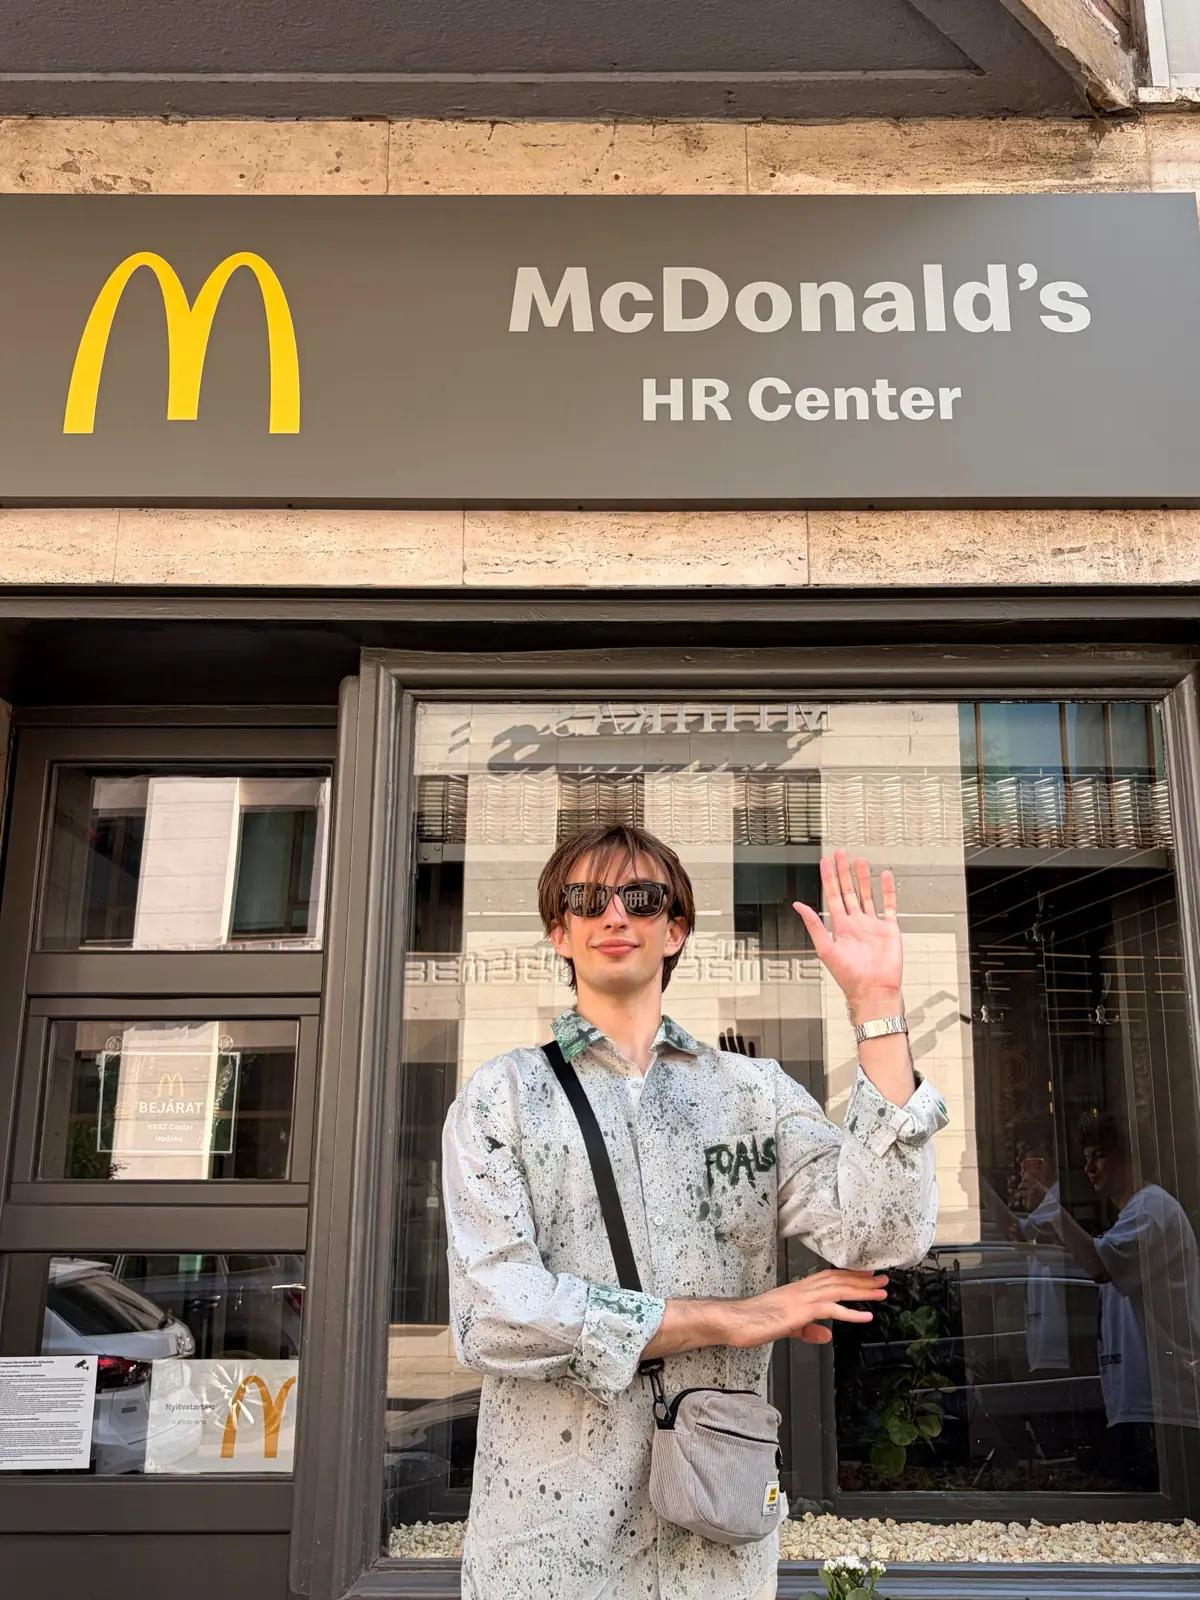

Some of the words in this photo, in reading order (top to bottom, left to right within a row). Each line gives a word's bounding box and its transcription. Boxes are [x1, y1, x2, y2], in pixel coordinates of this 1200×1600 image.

[508, 263, 1092, 333] McDonald’s
[643, 378, 732, 422] HR
[748, 378, 962, 422] Center
[139, 1099, 203, 1114] BEJÁRAT
[703, 1135, 776, 1191] FOALS
